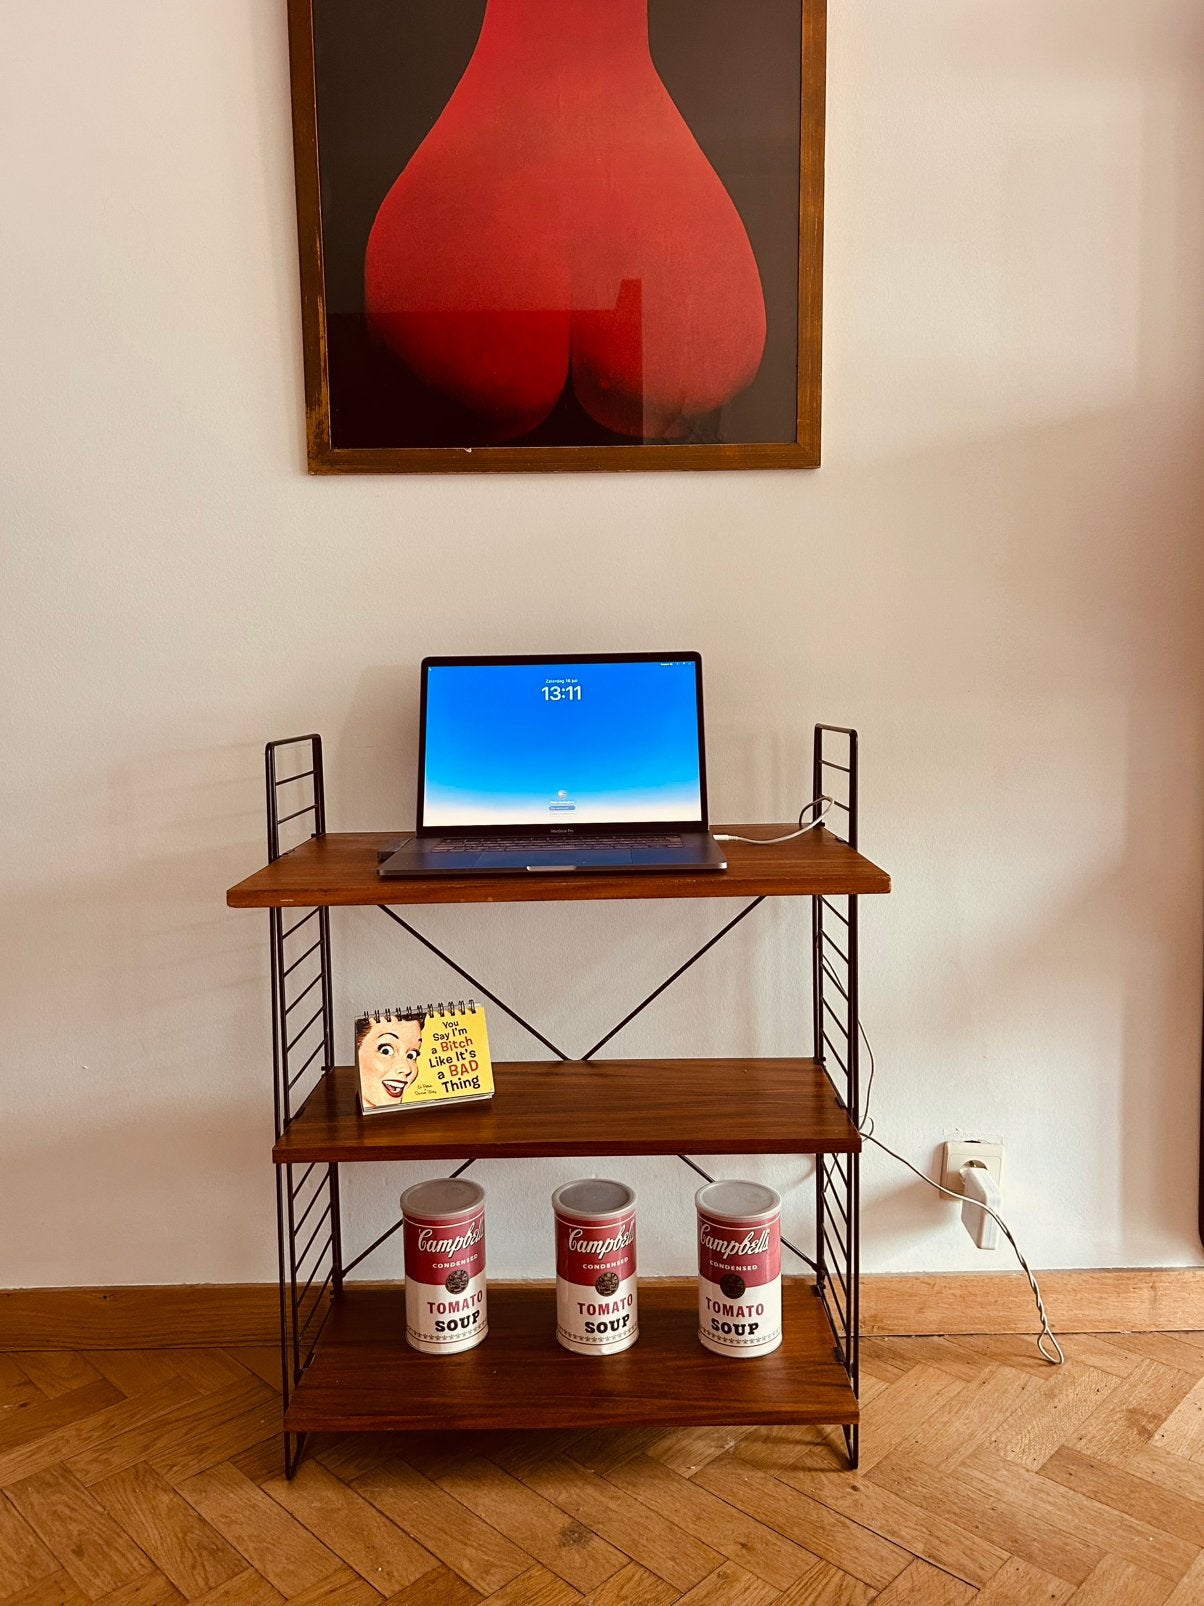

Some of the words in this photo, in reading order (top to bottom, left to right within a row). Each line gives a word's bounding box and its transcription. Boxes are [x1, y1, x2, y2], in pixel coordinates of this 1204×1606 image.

[541, 685, 582, 701] 13:11
[432, 1032, 450, 1042] Say
[452, 1027, 468, 1037] I'm
[442, 1021, 459, 1029] You
[431, 1047, 438, 1055] a
[440, 1036, 473, 1052] Bitch
[428, 1056, 453, 1068] Like
[455, 1048, 477, 1062] It's
[437, 1071, 446, 1080] a
[448, 1059, 479, 1077] BAD
[441, 1075, 481, 1093] Thing
[432, 1253, 479, 1269] CONDENSED
[582, 1256, 629, 1270] CONDENSED
[709, 1260, 758, 1271] CONDENSED
[427, 1289, 483, 1315] TOMATO
[577, 1293, 633, 1316] TOMATO
[705, 1296, 764, 1318] TOMATO
[435, 1309, 480, 1333] SOUP
[584, 1313, 630, 1334] SOUP
[711, 1317, 759, 1336] SOUP
